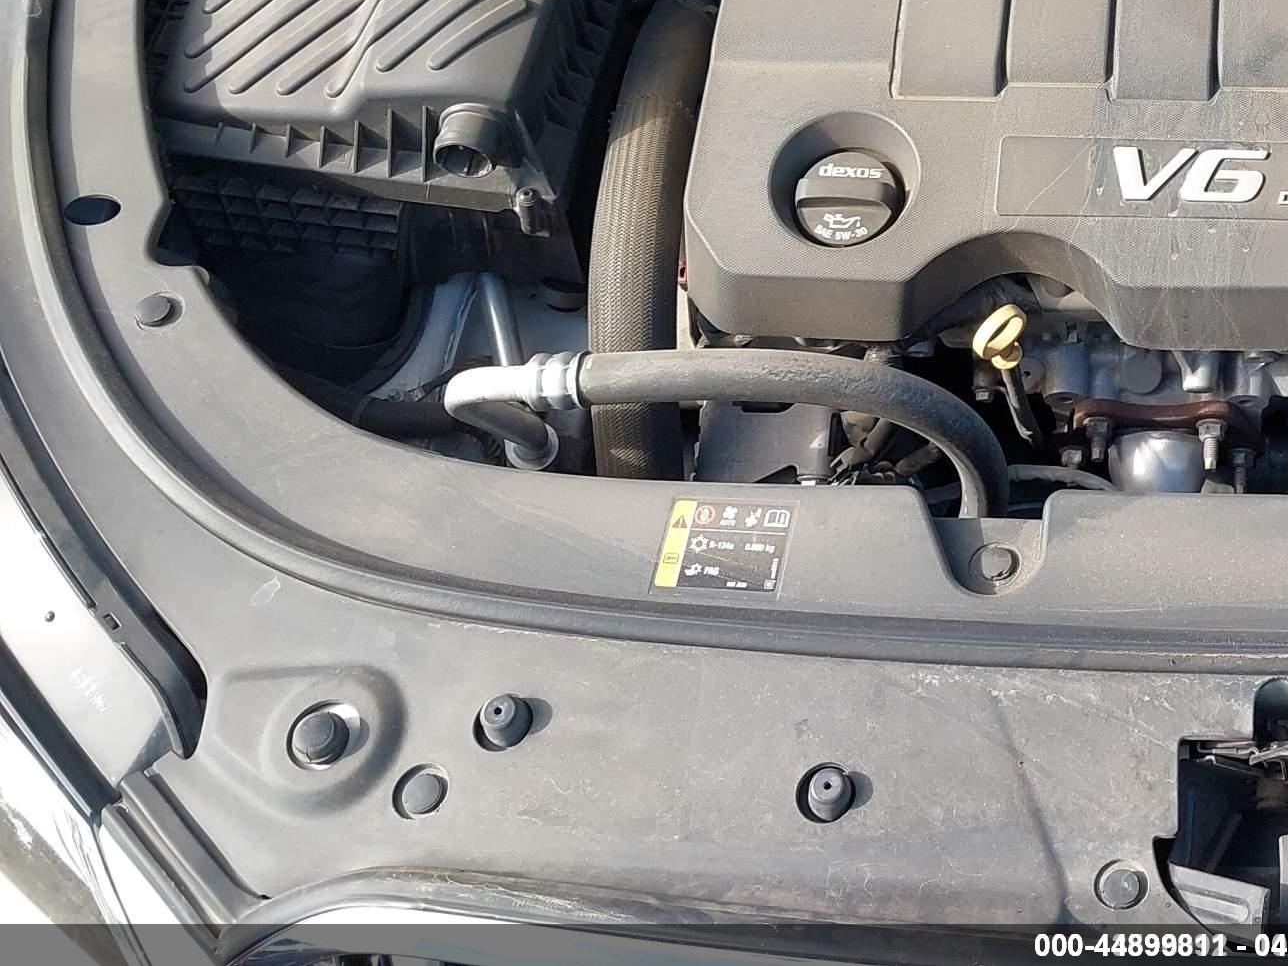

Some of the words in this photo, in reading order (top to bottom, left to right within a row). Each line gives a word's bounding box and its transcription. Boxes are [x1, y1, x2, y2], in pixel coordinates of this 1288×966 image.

[819, 163, 884, 179] dexos
[1113, 146, 1270, 202] V6
[814, 224, 833, 239] SAE
[835, 227, 868, 240] 5W-30
[719, 519, 737, 527] AUTO
[703, 566, 720, 576] PAG
